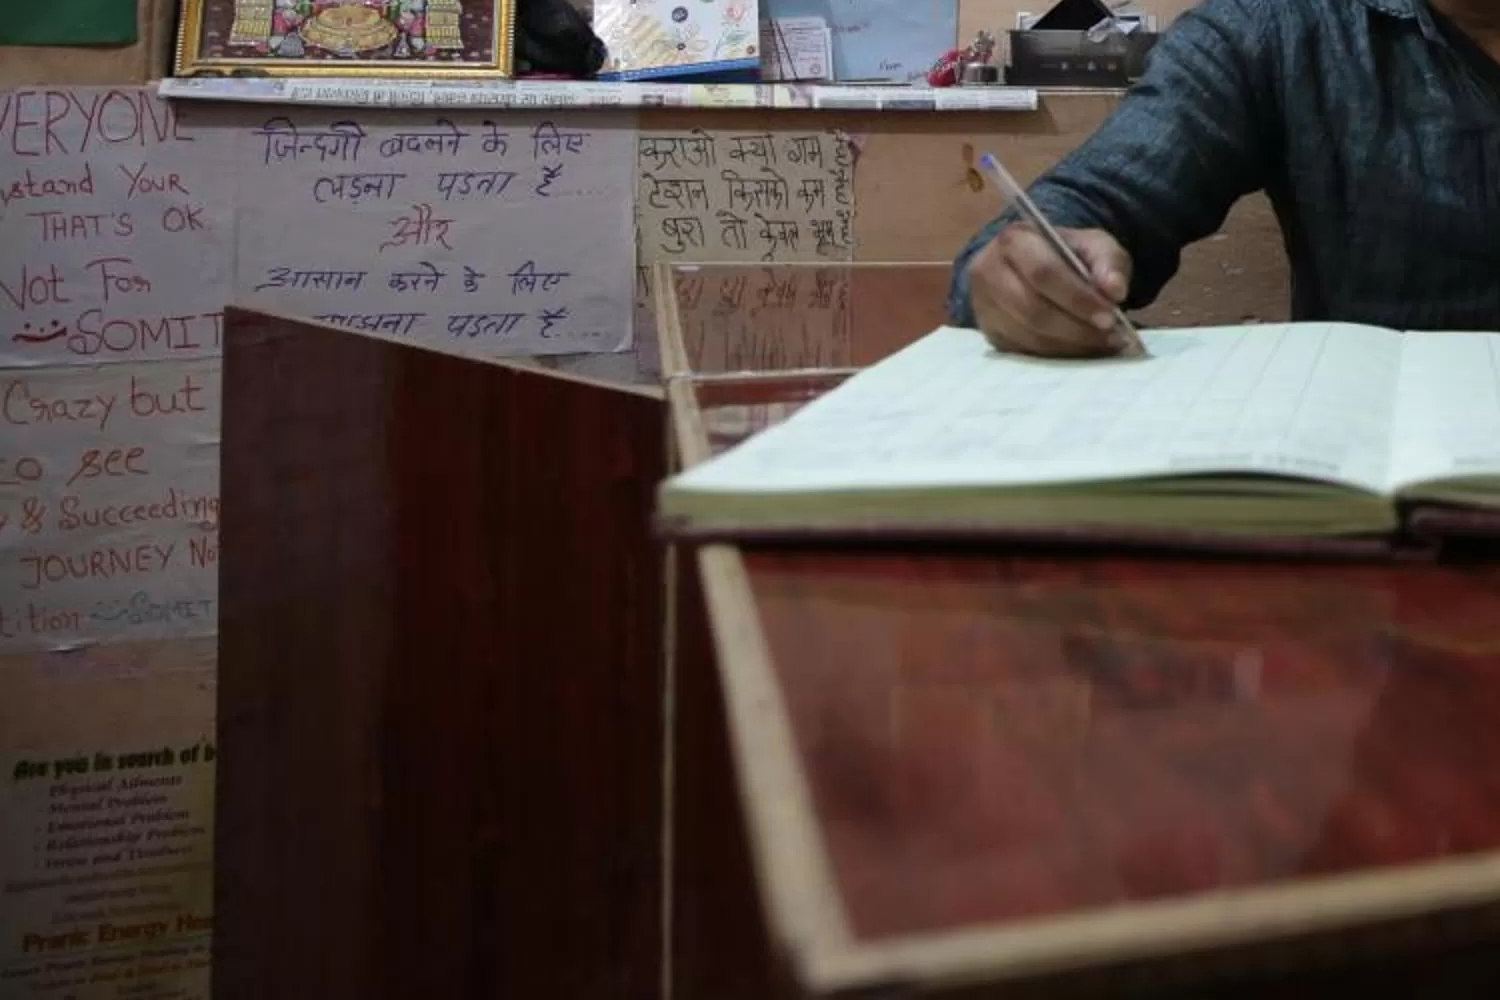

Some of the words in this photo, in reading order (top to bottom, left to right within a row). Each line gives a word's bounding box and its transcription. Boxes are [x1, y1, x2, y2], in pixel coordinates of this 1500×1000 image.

[481, 118, 510, 159] के
[532, 118, 592, 160] लिए
[27, 209, 134, 242] THAT'S
[162, 203, 205, 233] OK
[379, 202, 457, 252] और
[255, 266, 369, 293] आसान
[508, 260, 571, 297] लिए
[67, 307, 224, 356] SOMIT
[130, 375, 207, 418] but
[58, 488, 220, 532] Succeeding
[20, 540, 176, 590] JOURNEY
